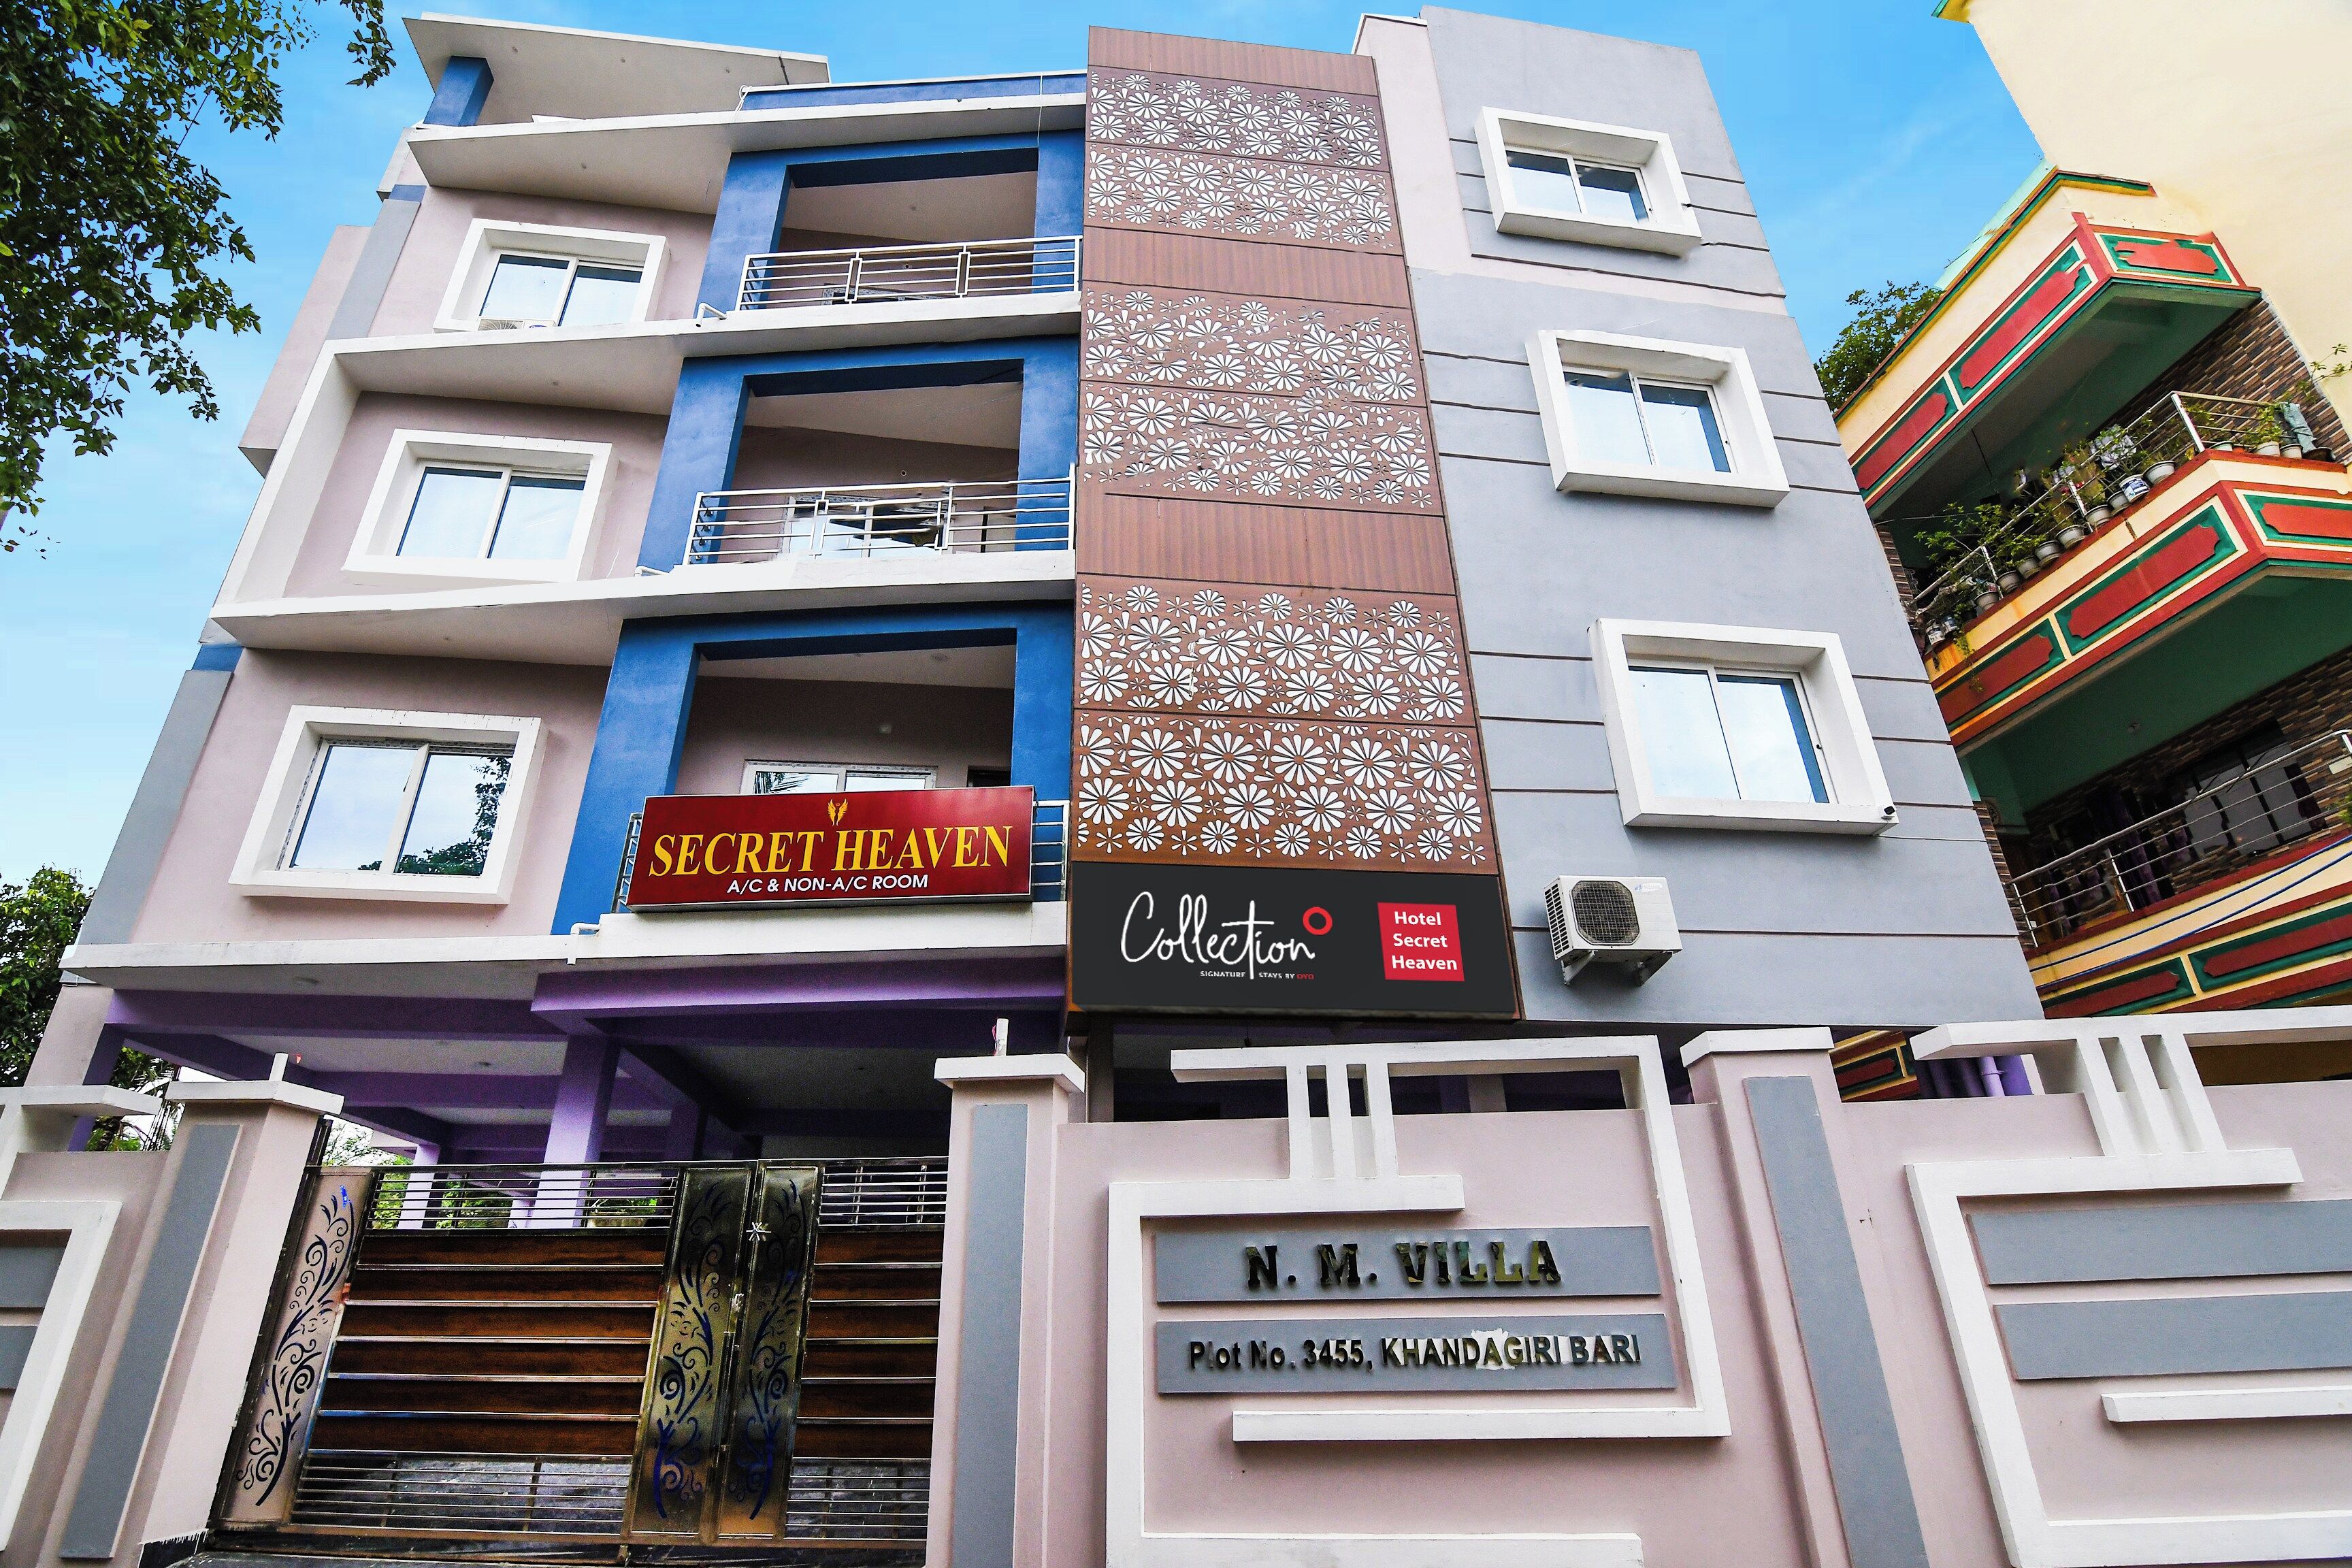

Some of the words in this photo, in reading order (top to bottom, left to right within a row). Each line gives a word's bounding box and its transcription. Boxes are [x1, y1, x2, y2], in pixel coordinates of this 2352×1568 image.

[649, 830, 825, 876] SECRET
[831, 825, 1013, 872] HEAVEN
[727, 878, 763, 895] A/C
[767, 879, 780, 893] &
[784, 876, 868, 892] NON-A/C
[872, 874, 929, 889] ROOM
[1394, 911, 1442, 926] Hotel
[1121, 890, 1316, 980] Collection
[1392, 932, 1449, 948] Secret
[1391, 954, 1458, 970] Heaven
[1245, 1243, 1296, 1288] N.
[1318, 1243, 1377, 1286] M.
[1394, 1240, 1562, 1284] VILLA
[1189, 1340, 1241, 1369] Plot
[1250, 1339, 1296, 1369] No.
[1303, 1337, 1374, 1373] 3455,
[1380, 1335, 1562, 1367] KHANDAGIRI
[1569, 1333, 1642, 1365] BARI
